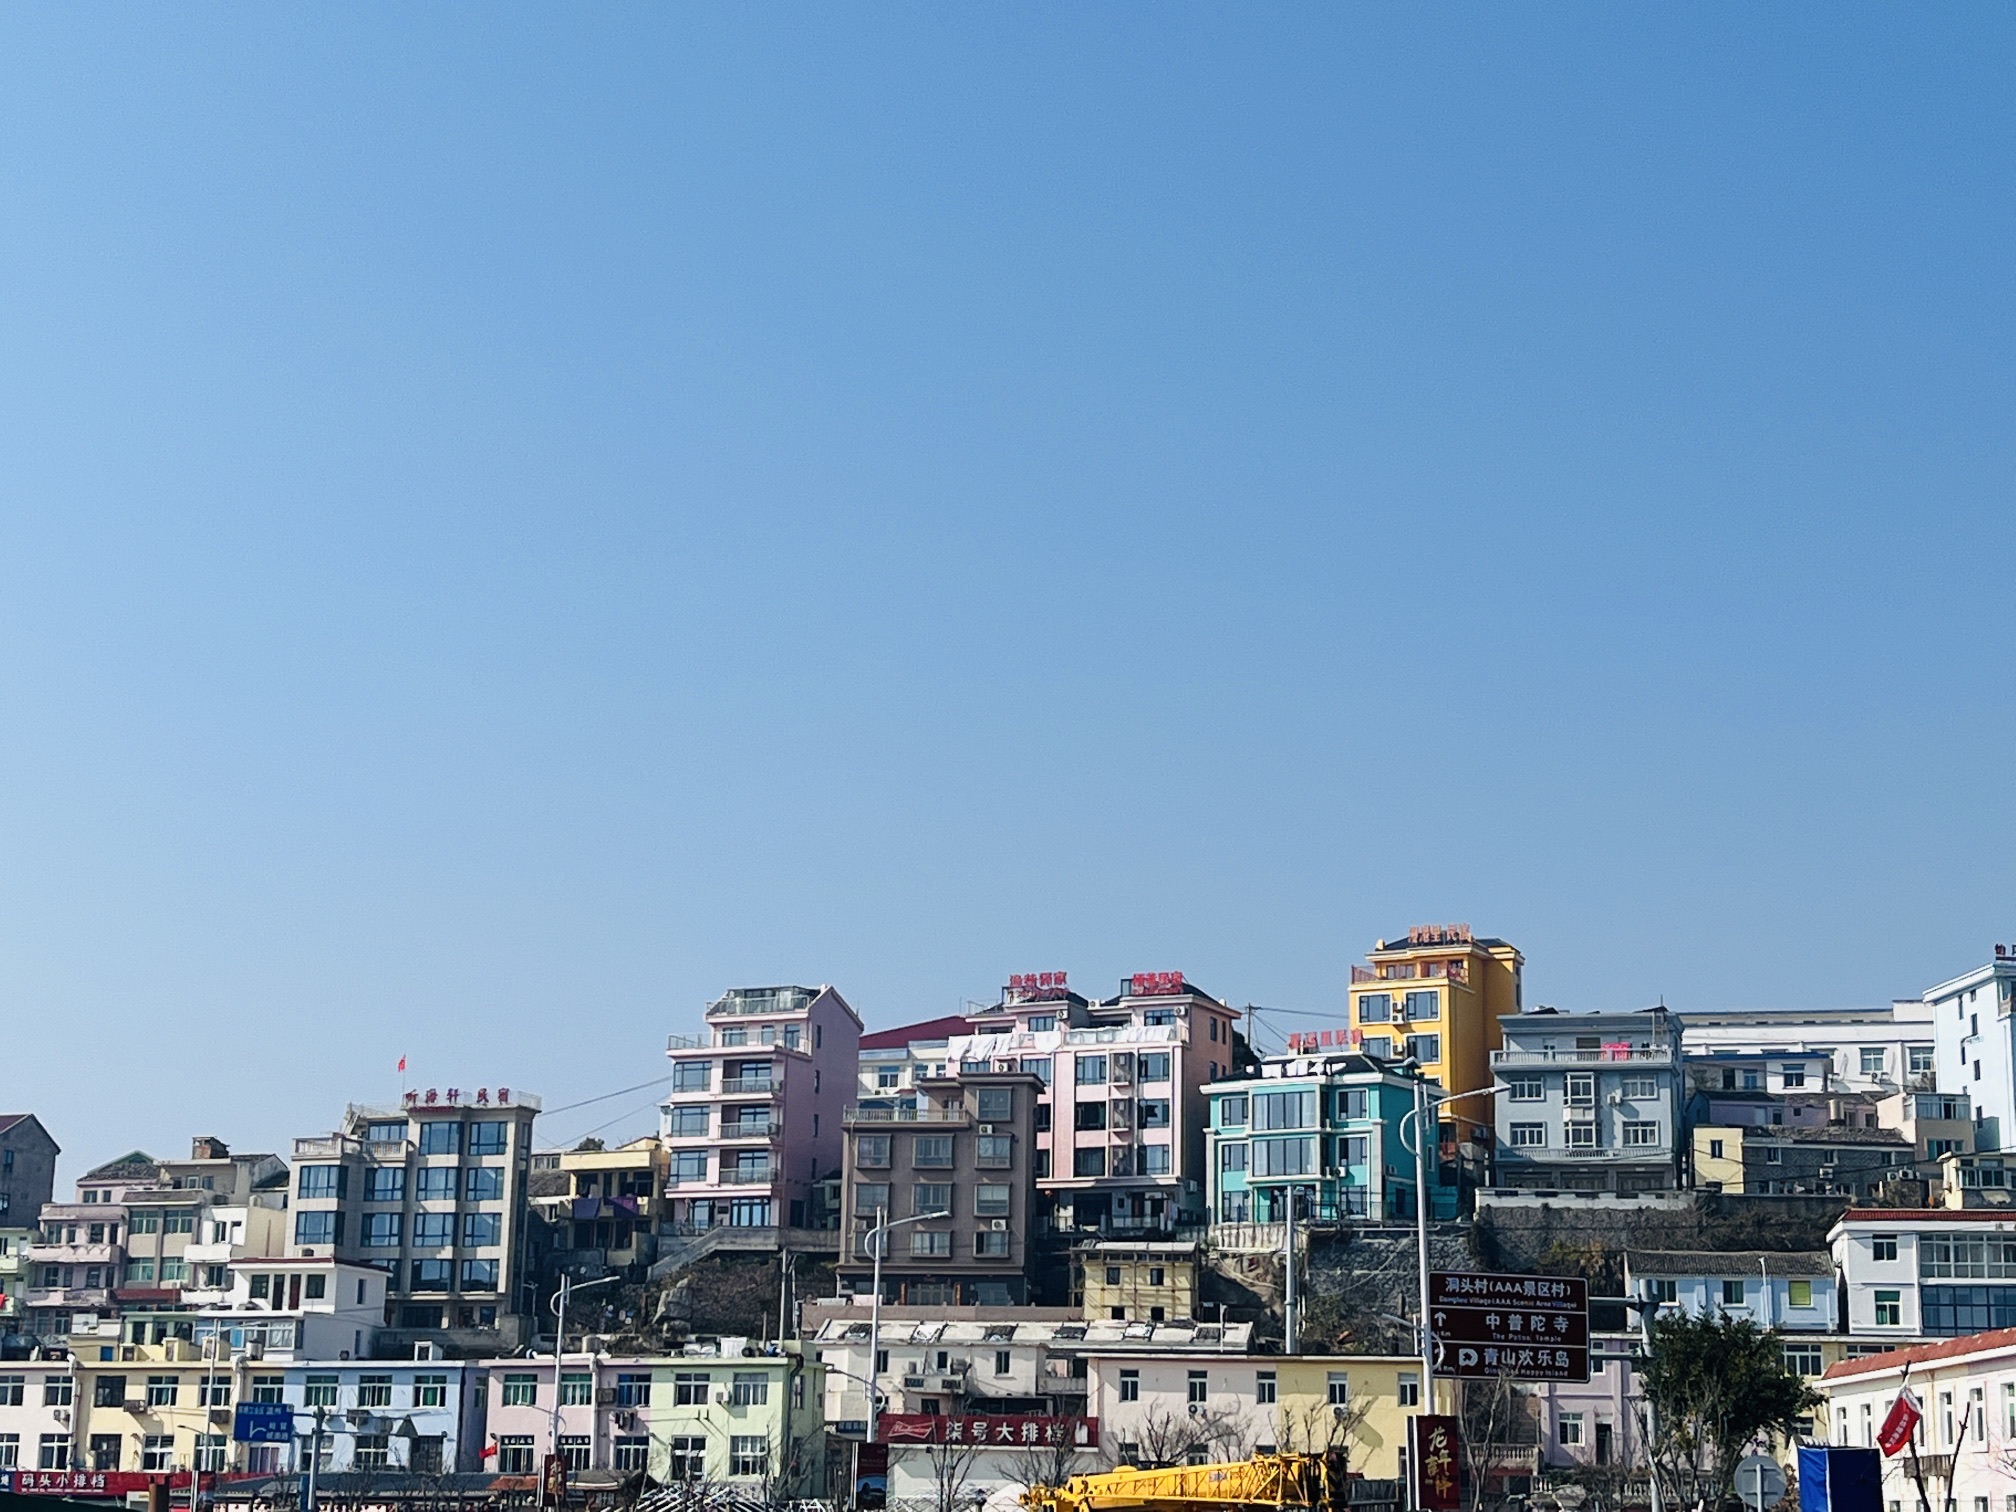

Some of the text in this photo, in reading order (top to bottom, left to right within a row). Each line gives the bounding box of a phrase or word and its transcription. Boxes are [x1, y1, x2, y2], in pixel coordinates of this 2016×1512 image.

[1486, 1313, 1569, 1333] 中普陀寺
[1484, 1347, 1569, 1368] 青山欢乐岛
[21, 1473, 106, 1488] 码头小排档
